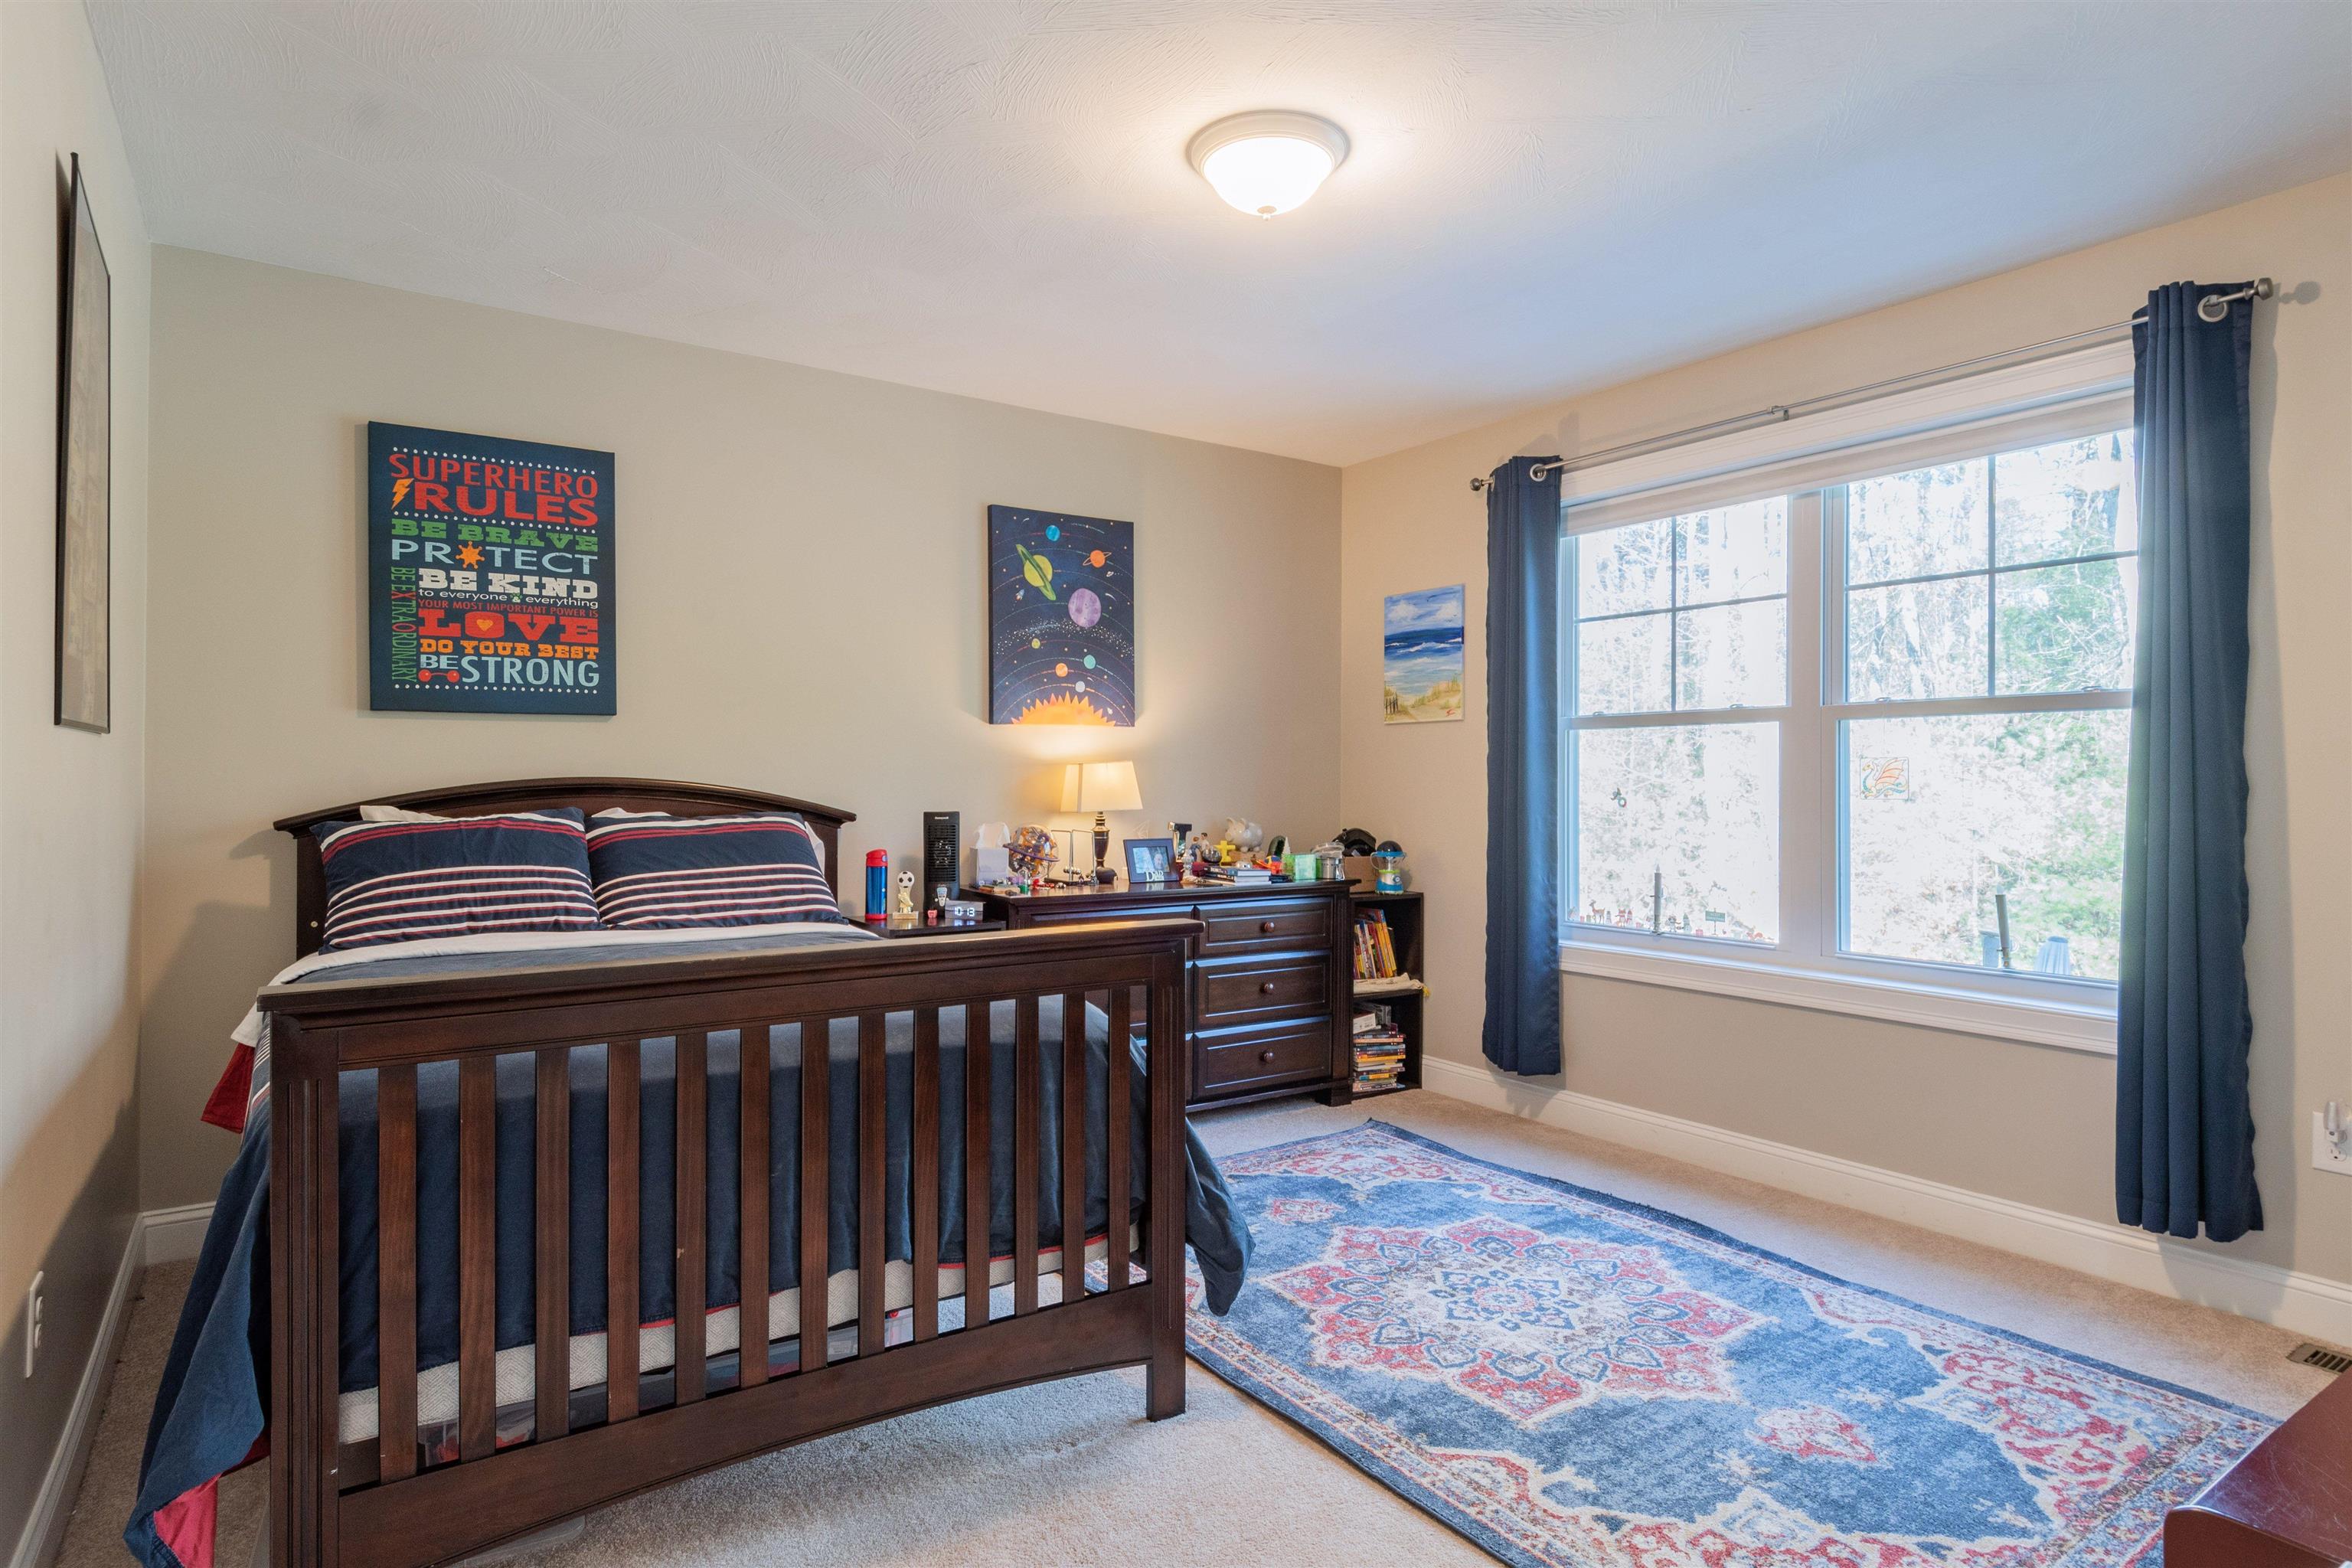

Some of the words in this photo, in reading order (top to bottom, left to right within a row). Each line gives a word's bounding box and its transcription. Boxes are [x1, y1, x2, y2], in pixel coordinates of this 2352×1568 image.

[389, 454, 598, 498] SUPERHERO
[414, 482, 598, 527] RULES
[392, 518, 446, 539] BE
[458, 524, 598, 552] BRAVE
[391, 567, 416, 581] BE
[419, 568, 477, 591] BE
[488, 573, 598, 599] KIND
[418, 589, 434, 597] to
[439, 591, 508, 601] everyone
[525, 596, 598, 609] everything
[418, 599, 449, 608] YOUR
[453, 601, 483, 610] MOST
[487, 603, 547, 614] IMPORTANT
[550, 607, 586, 617] POWER
[589, 609, 599, 618] IS
[391, 584, 417, 682] EXTRAORDINARY
[418, 609, 599, 644] LOVE
[420, 639, 453, 653] DO
[460, 640, 531, 657] YOUR
[537, 644, 599, 660] BEST
[420, 655, 459, 669] BE
[461, 655, 599, 688] STRONG
